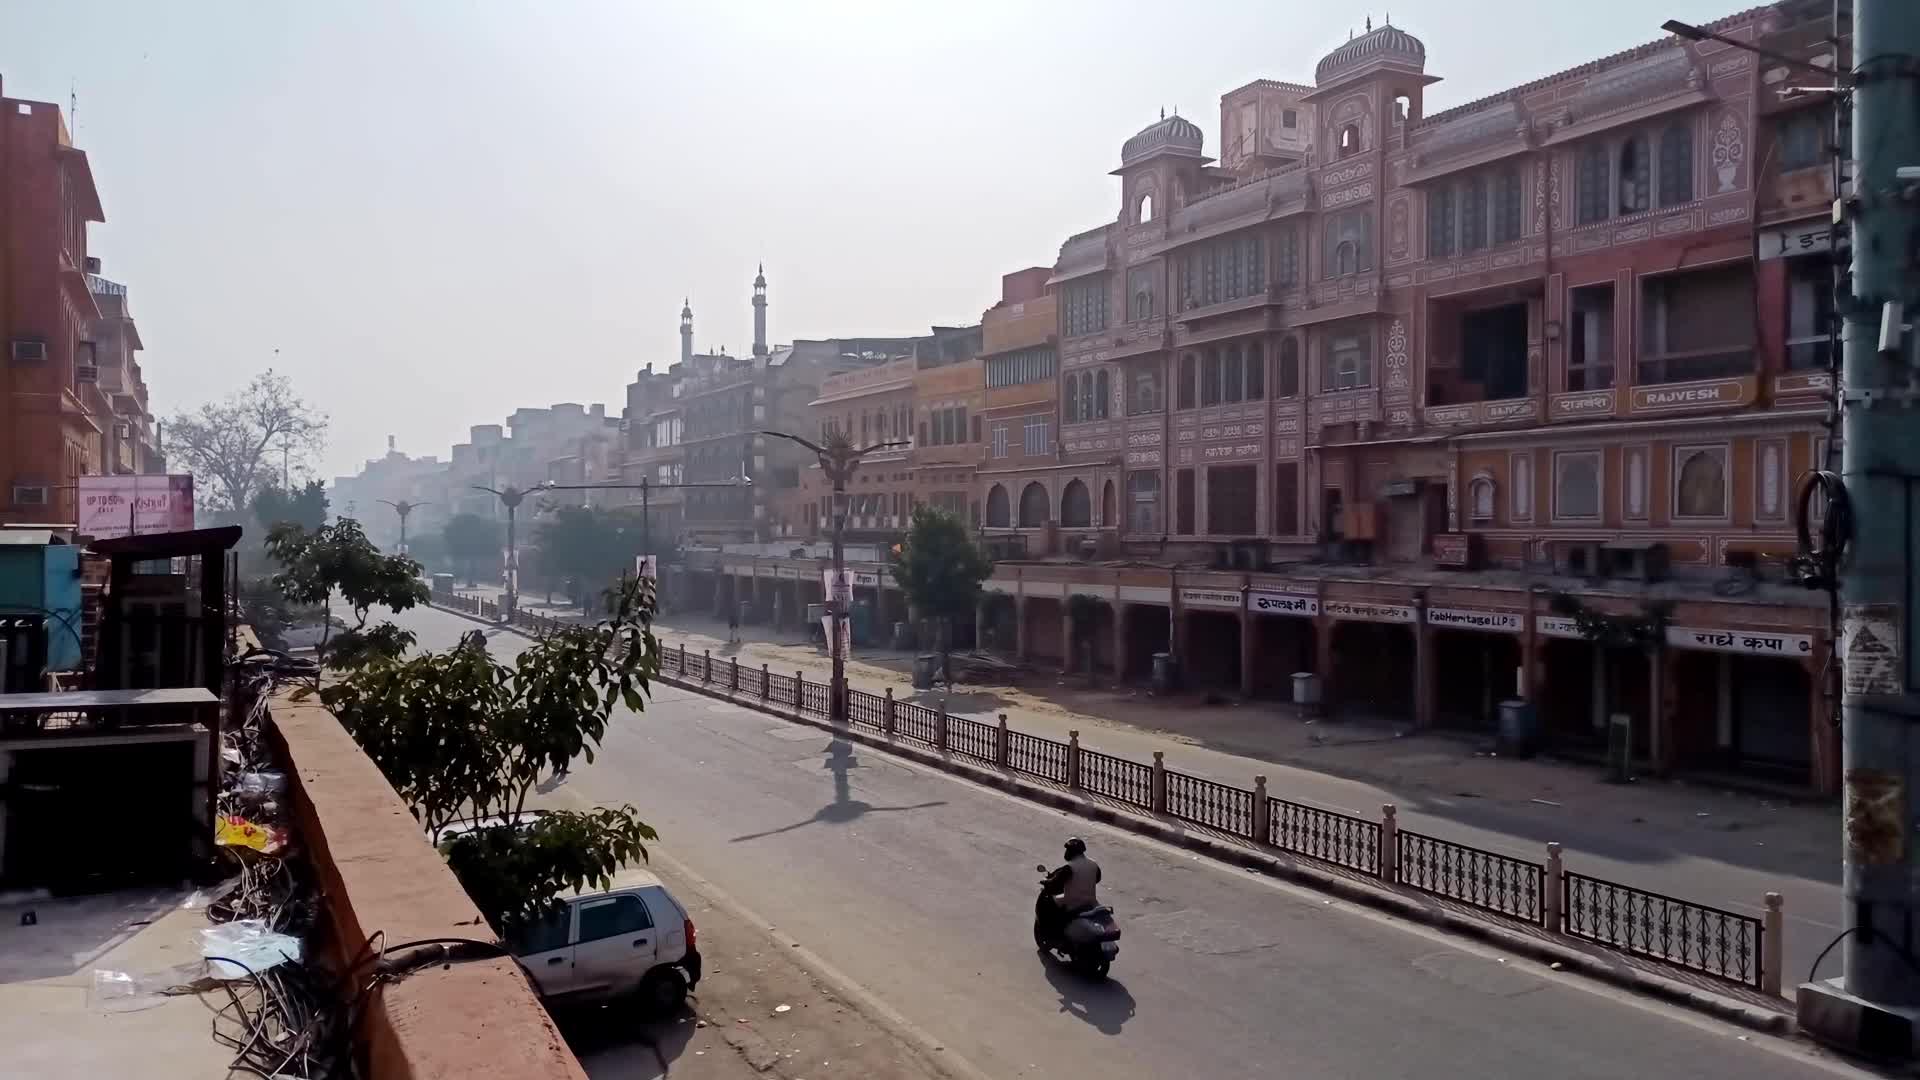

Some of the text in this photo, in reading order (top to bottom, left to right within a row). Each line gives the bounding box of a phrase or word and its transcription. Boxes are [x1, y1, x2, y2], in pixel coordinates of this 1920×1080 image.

[1646, 388, 1720, 404] RAJVESH
[86, 495, 97, 506] UP
[98, 495, 107, 506] TO
